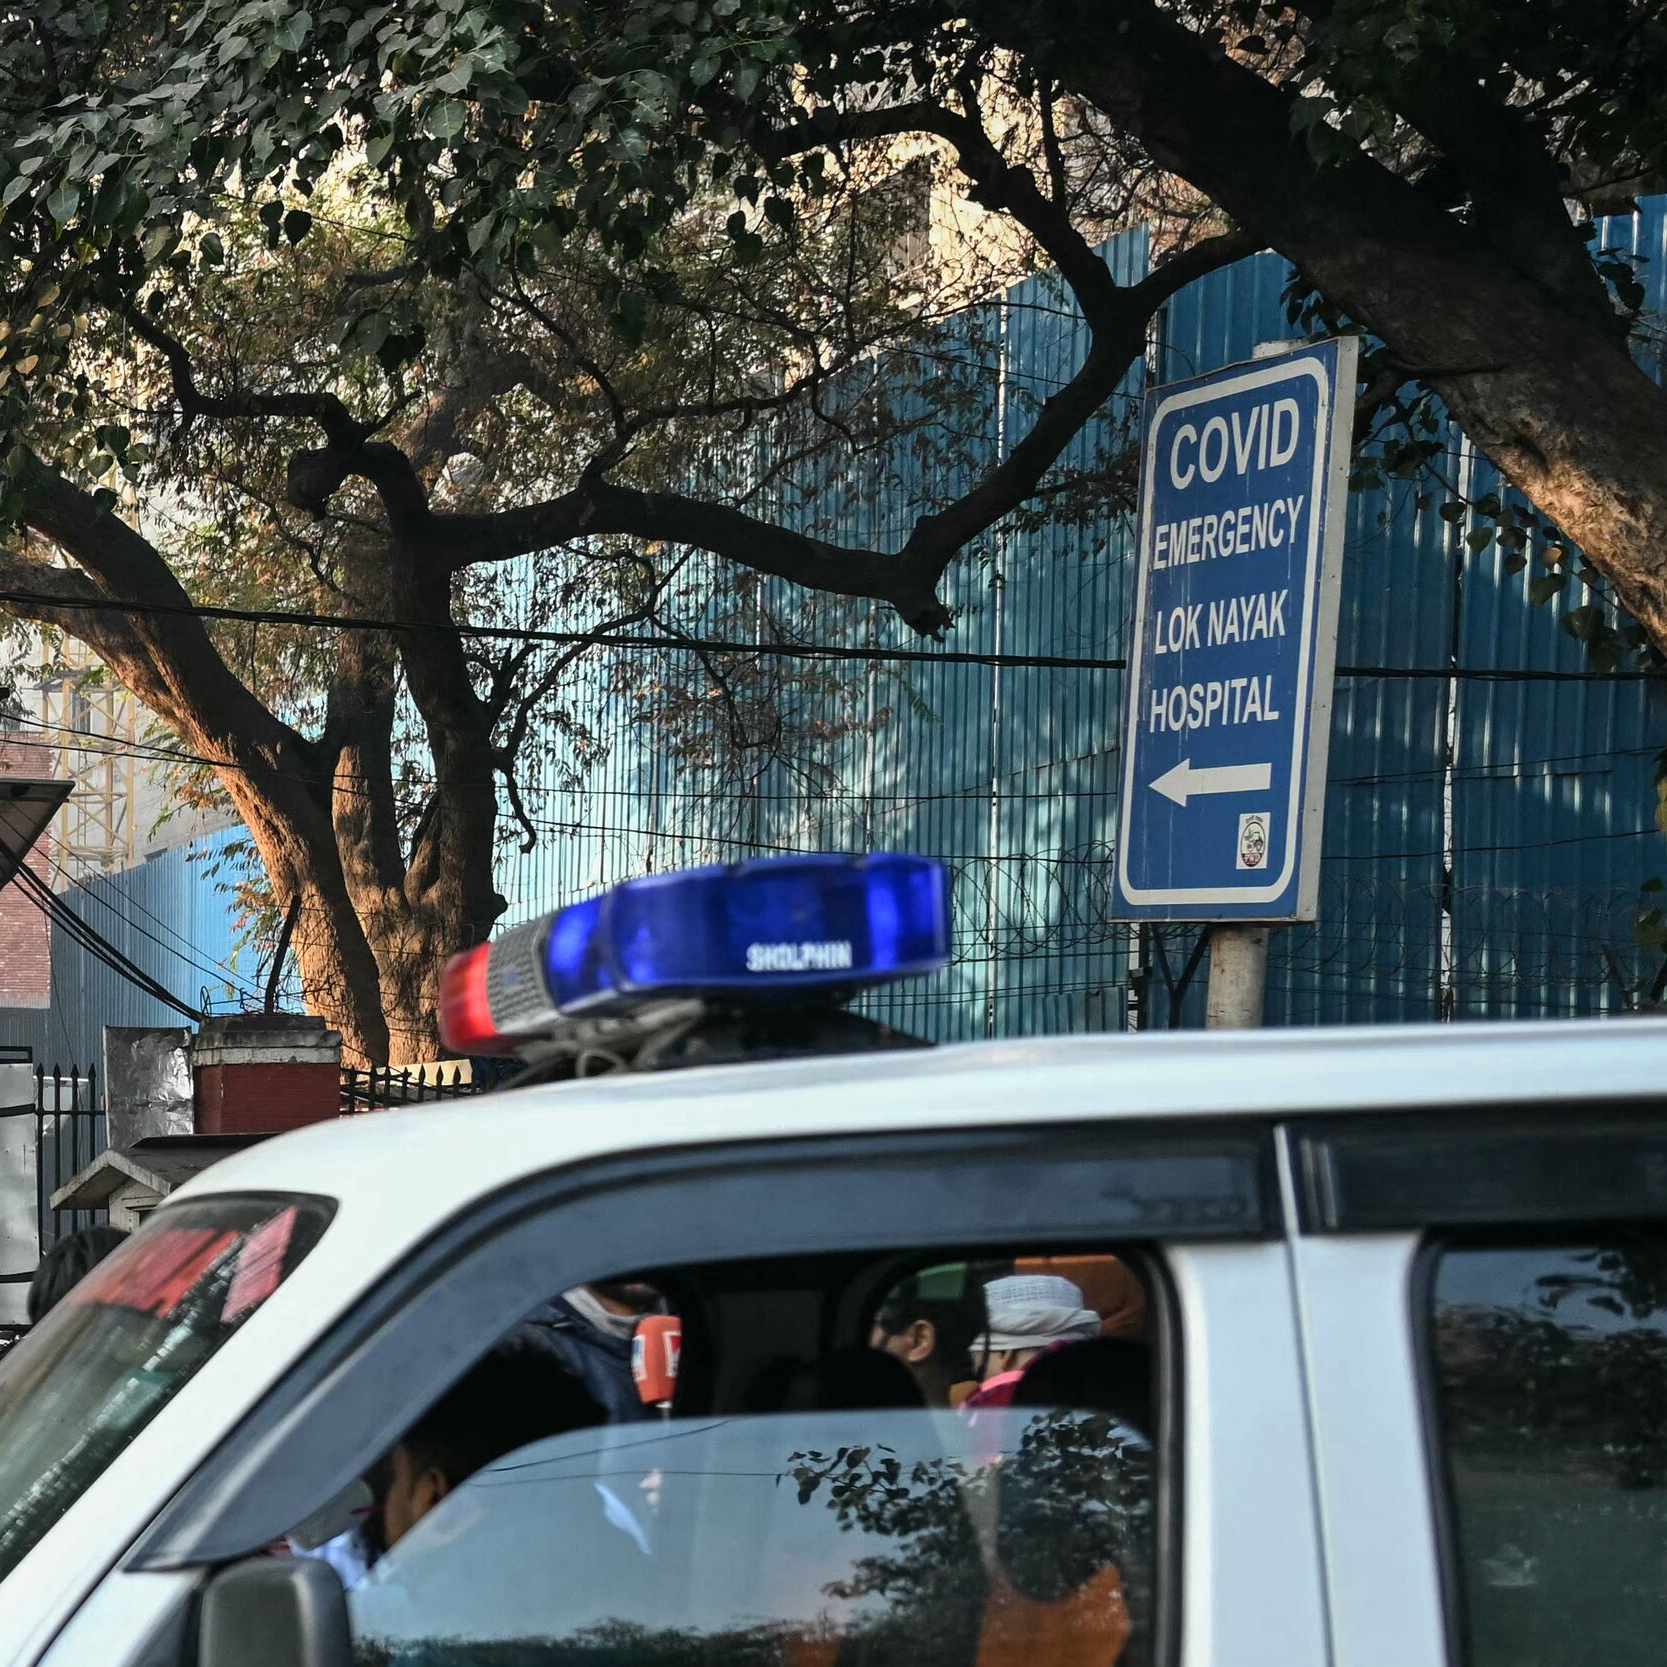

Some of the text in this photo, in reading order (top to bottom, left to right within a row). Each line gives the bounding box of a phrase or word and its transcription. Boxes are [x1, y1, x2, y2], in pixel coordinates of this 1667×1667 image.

[1169, 396, 1300, 490] COVID
[1153, 495, 1304, 570] EMERGENCY
[1154, 589, 1289, 655] LOK NAYAK
[1149, 676, 1279, 734] HOSPITAL
